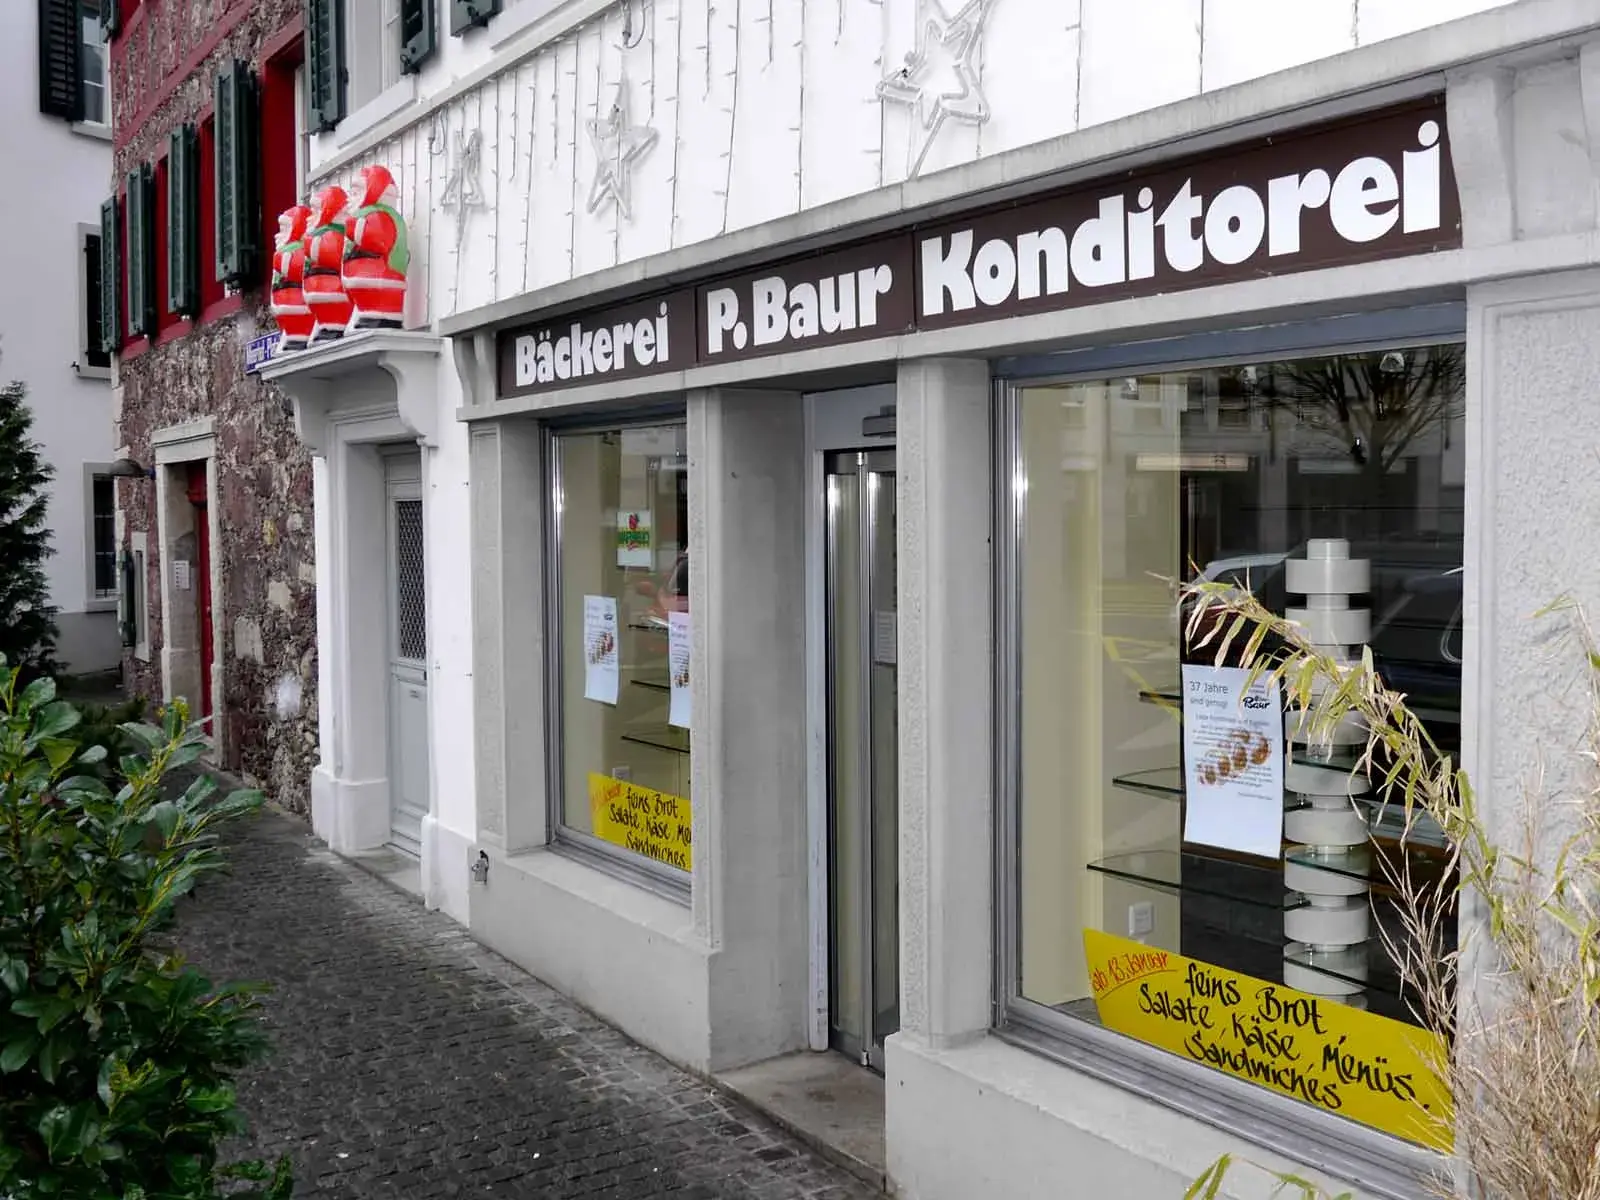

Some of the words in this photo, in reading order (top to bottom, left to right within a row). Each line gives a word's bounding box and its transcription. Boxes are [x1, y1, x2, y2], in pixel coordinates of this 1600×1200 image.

[514, 302, 669, 387] Bäckerei
[921, 120, 1441, 316] Konditorei
[1190, 681, 1201, 692] 37
[1204, 682, 1229, 694] Jahre
[1243, 696, 1271, 709] Baur
[1184, 962, 1242, 1007] feins
[1184, 1030, 1343, 1110] Sandwiches
